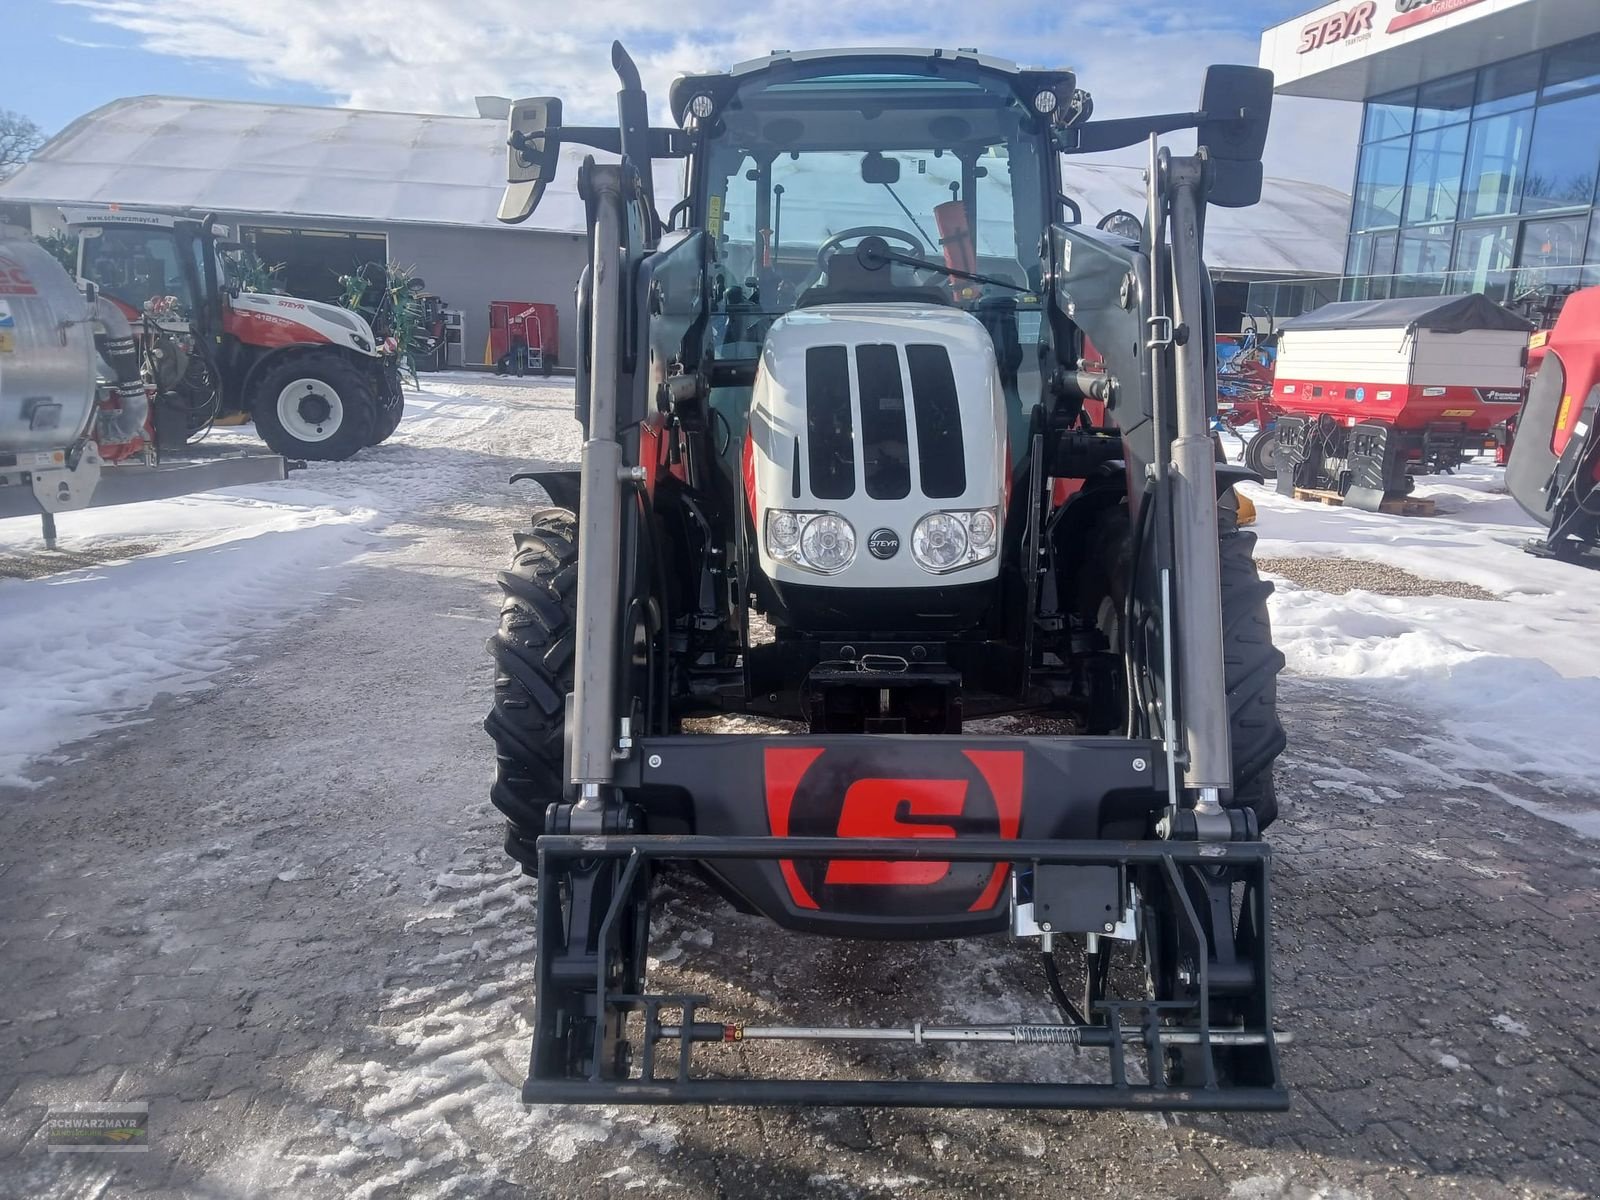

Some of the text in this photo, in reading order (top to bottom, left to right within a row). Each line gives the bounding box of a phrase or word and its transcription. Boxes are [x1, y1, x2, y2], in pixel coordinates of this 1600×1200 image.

[1296, 1, 1377, 54] STEYR
[86, 214, 160, 224] www.schwarzmayr.at
[278, 300, 305, 310] STEYR
